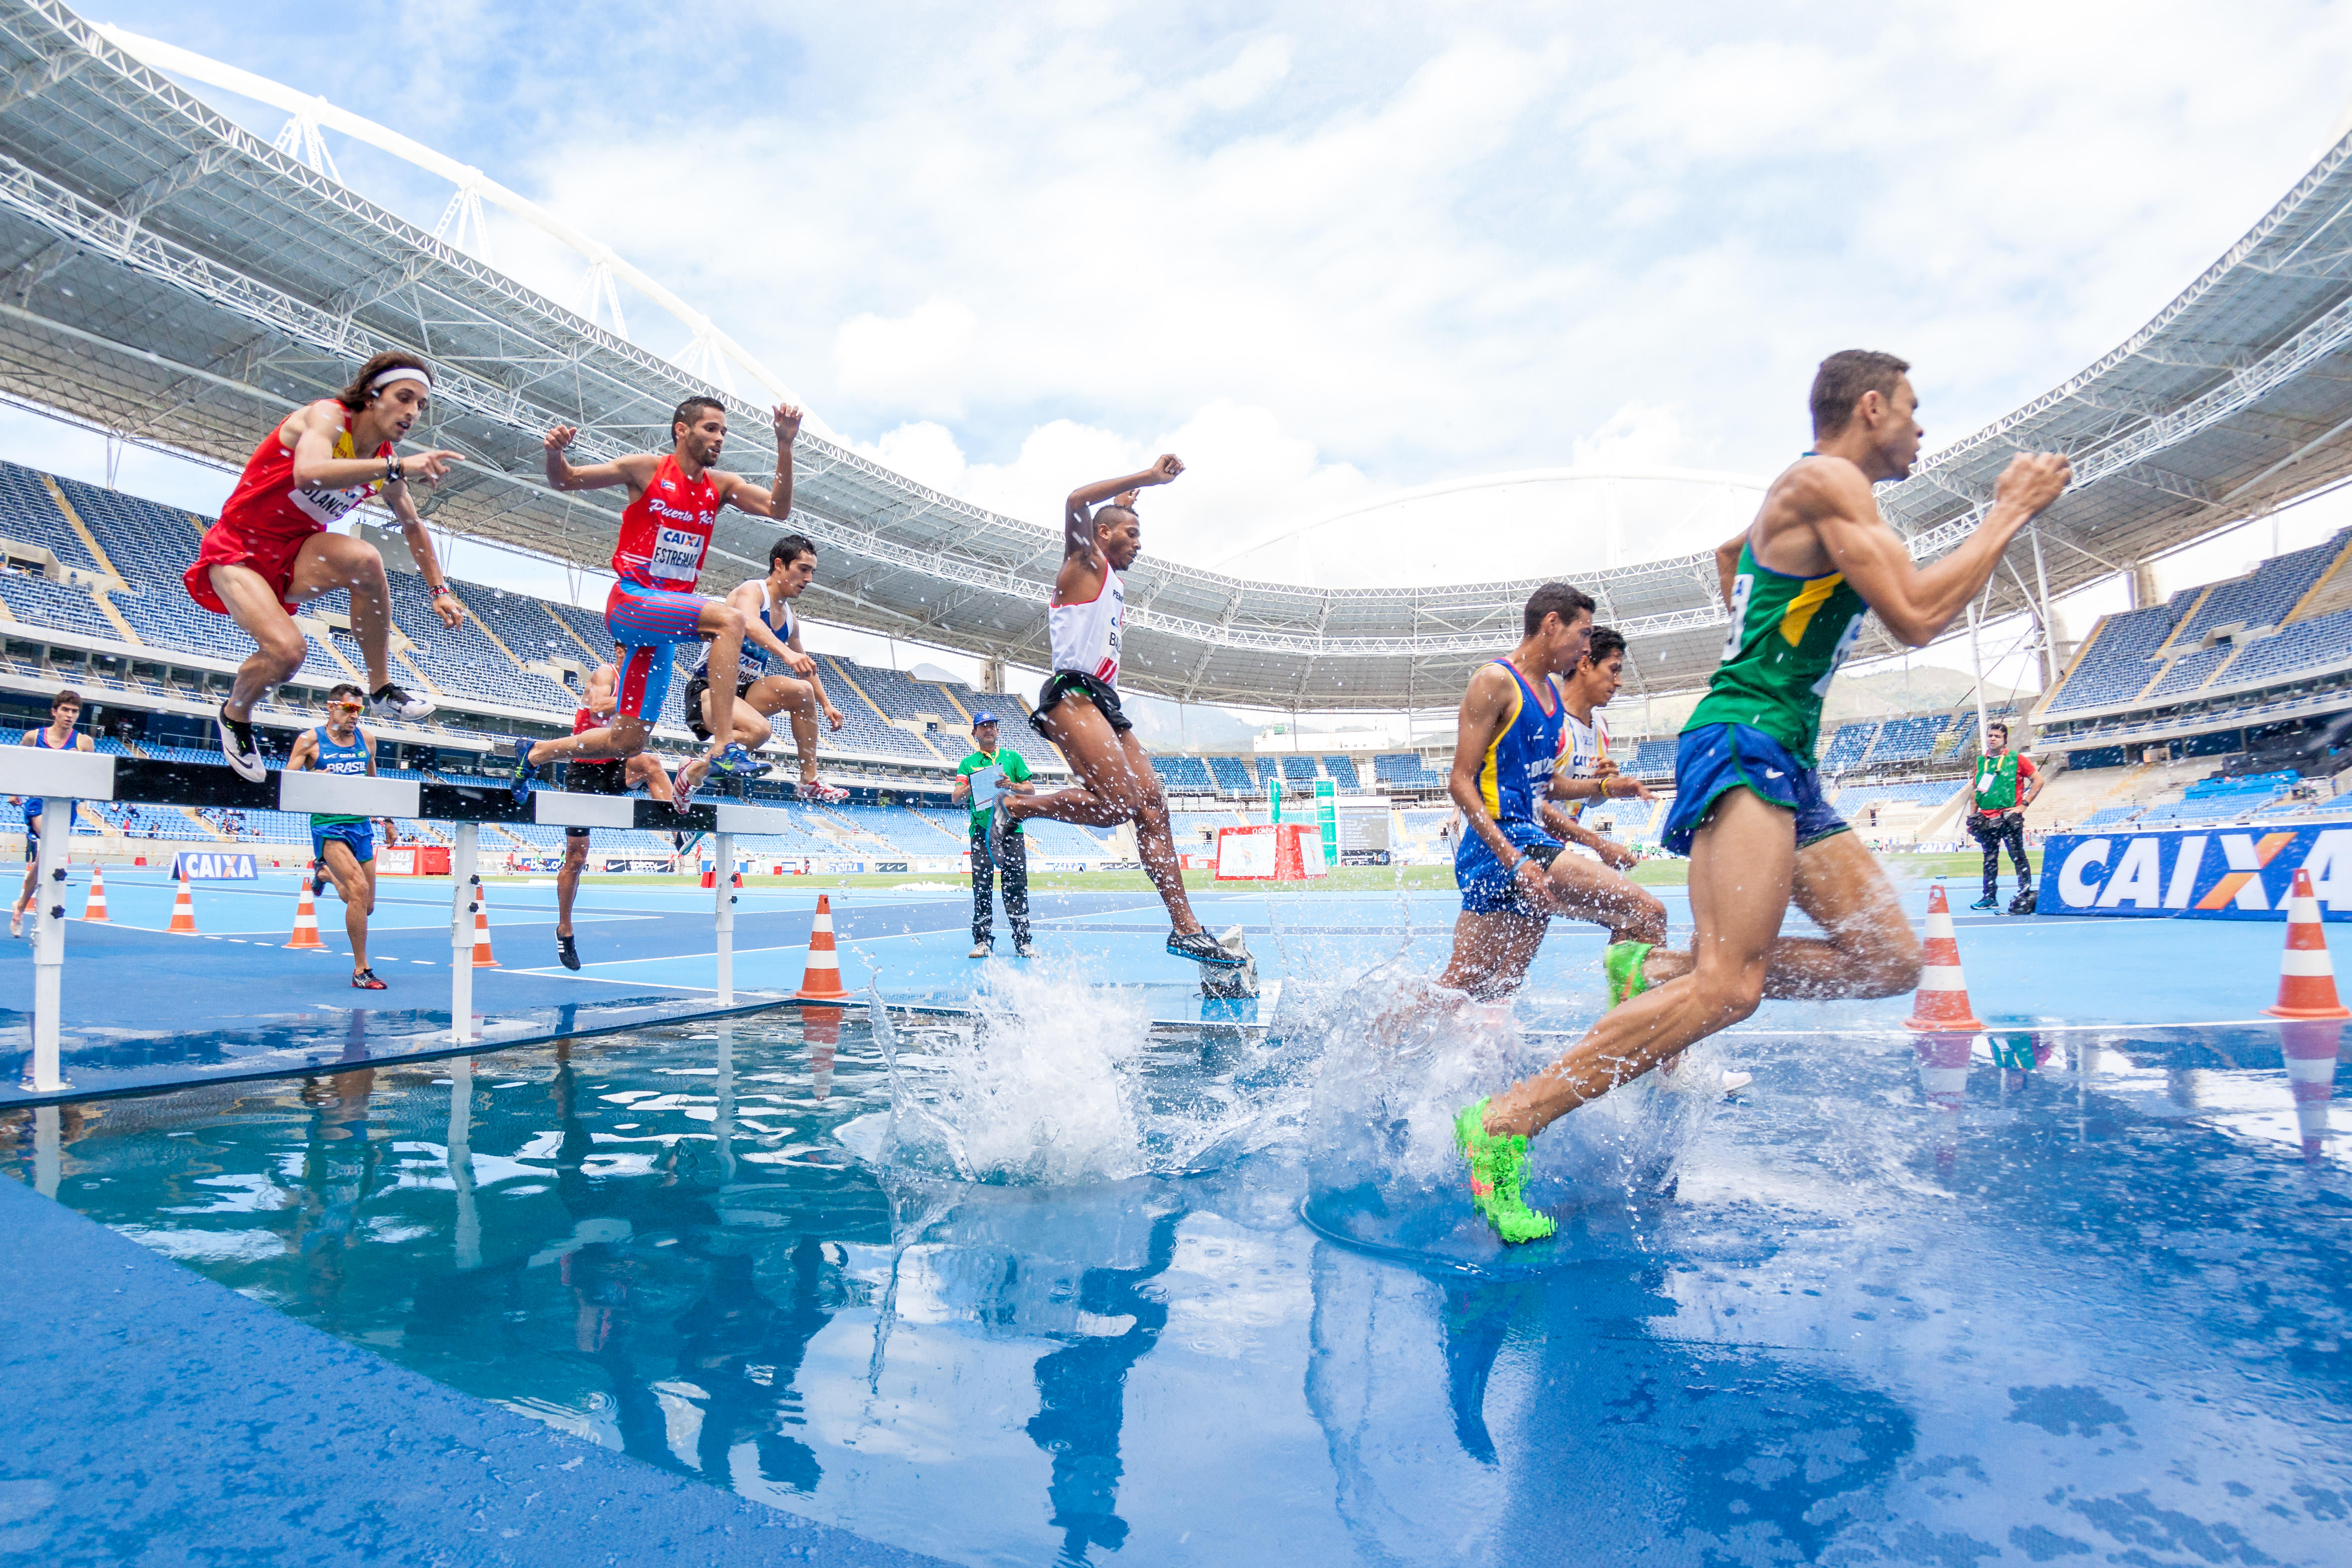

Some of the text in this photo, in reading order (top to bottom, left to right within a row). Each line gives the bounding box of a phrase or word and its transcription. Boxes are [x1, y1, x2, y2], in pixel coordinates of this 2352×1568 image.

[649, 499, 694, 522] Puerto
[389, 852, 410, 862] 3:42.5
[1919, 843, 1953, 853] CAIXA
[186, 854, 254, 878] CAIXA
[2058, 829, 2352, 911] CAIXA
